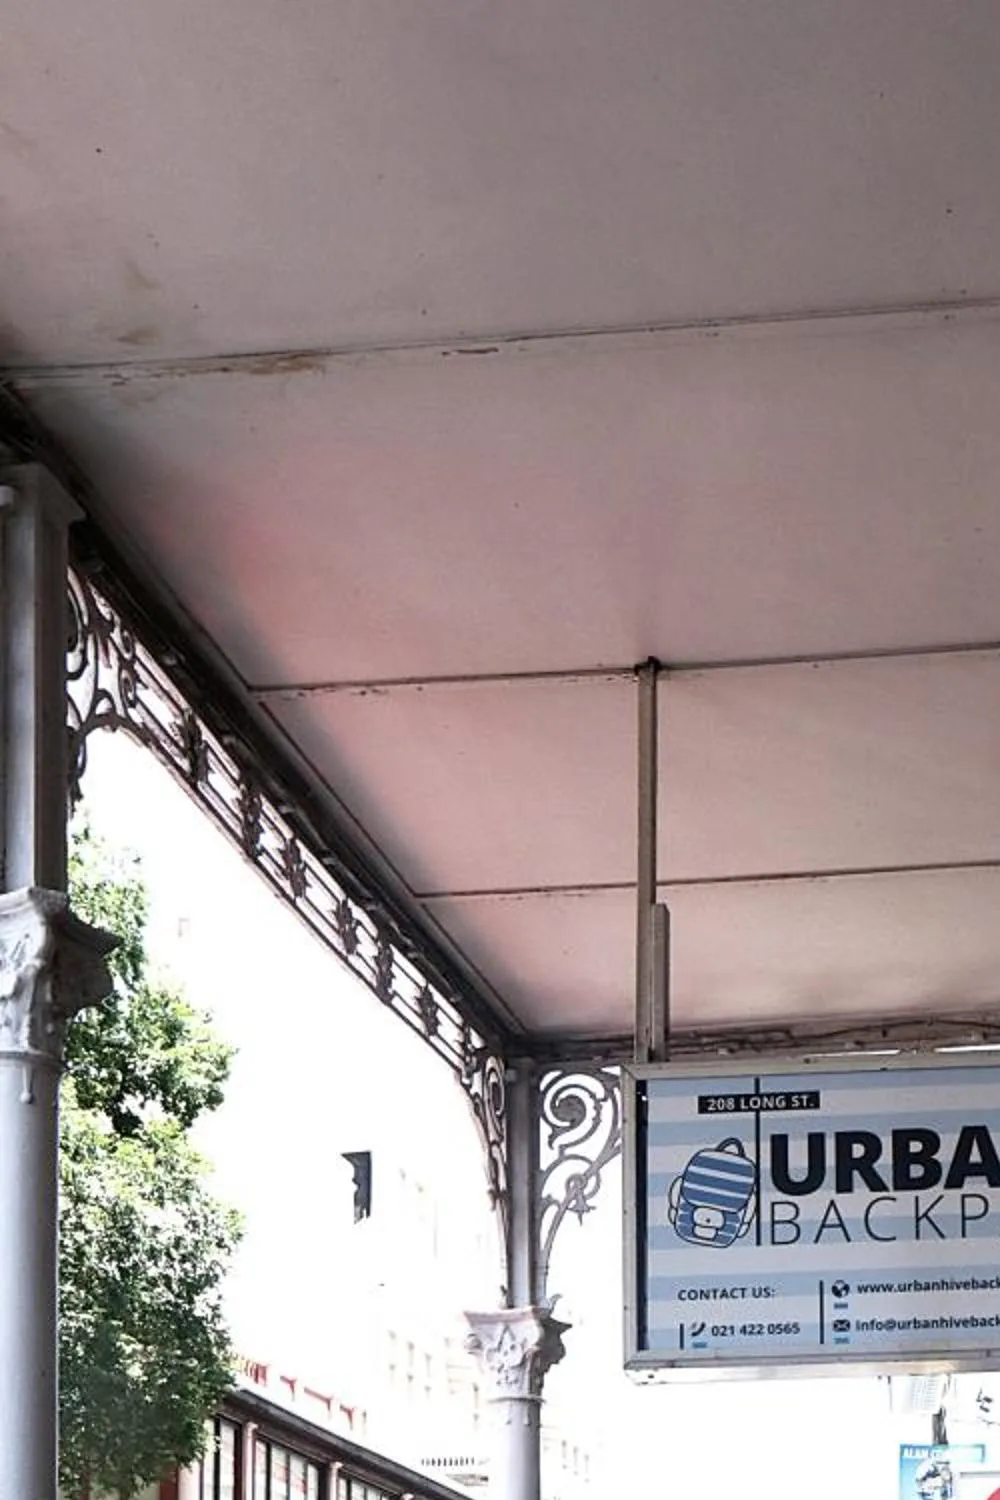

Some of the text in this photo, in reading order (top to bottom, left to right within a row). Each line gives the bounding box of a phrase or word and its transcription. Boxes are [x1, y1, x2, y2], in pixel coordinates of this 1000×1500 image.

[707, 1095, 815, 1111] 208 LONG ST.
[677, 1286, 776, 1301] CONTACT US:
[711, 1322, 801, 1337] 021 422 0565
